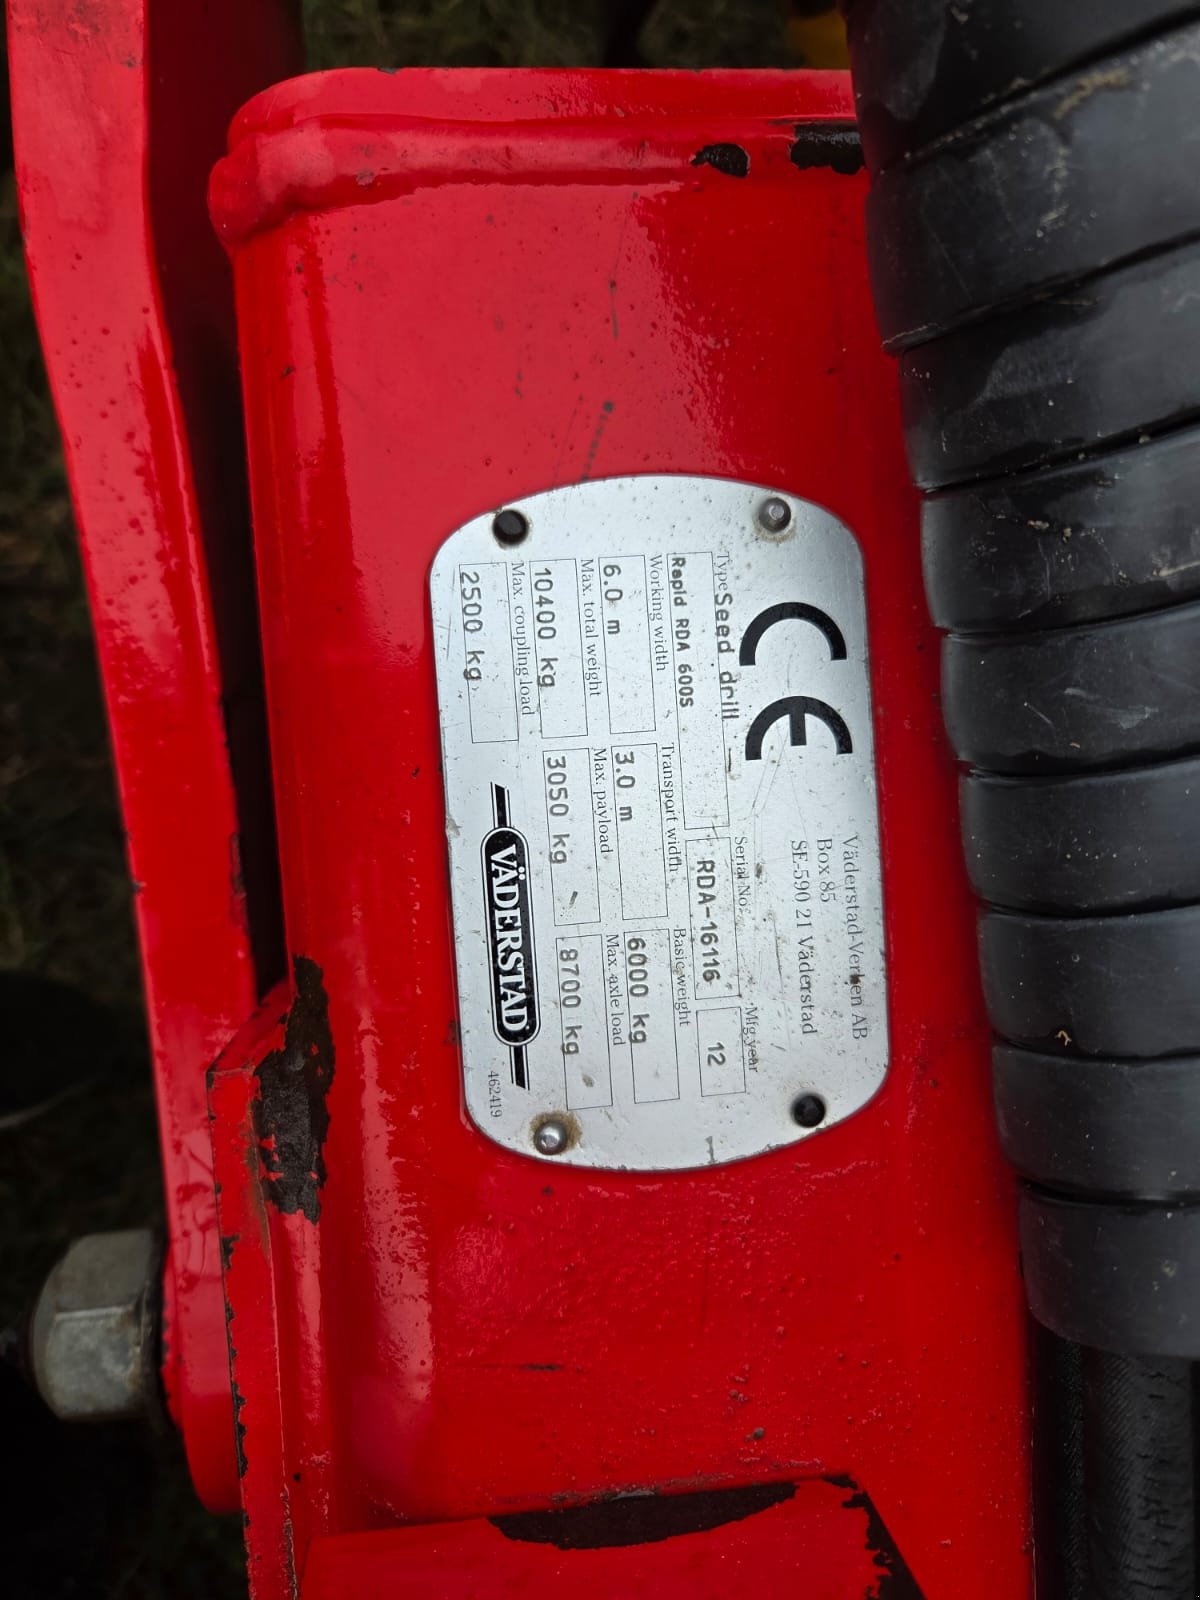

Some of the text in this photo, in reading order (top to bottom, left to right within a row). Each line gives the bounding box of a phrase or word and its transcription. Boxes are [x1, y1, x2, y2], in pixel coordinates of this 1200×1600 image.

[603, 564, 623, 635] 6.0 m
[650, 555, 669, 671] Working width
[714, 551, 730, 590] Type
[460, 571, 484, 680] 2500 kg
[512, 562, 535, 715] Max. coupling load
[534, 567, 558, 687] 10400 kg
[580, 559, 602, 697] Max. total weight
[669, 557, 694, 708] Rapid RDA 600S
[715, 592, 739, 720] Seed drill
[739, 602, 853, 761] CE
[547, 756, 570, 864] 3050 kg
[593, 748, 613, 854] Max. payload
[615, 751, 635, 821] 3.0 m
[661, 742, 682, 872] Transport width
[735, 836, 750, 880] Serial
[817, 838, 835, 903] Box 85
[490, 844, 529, 1031] VÄDERSTAD
[697, 860, 720, 982] RDA-16116
[792, 840, 817, 1035] SE-590 21 Väderstad
[560, 949, 583, 1055] 8700 kg
[606, 935, 626, 1046] Max. axle load
[627, 937, 650, 1044] 6000 kg
[673, 928, 691, 1027] Basic weight
[852, 1013, 868, 1040] AB
[488, 1071, 502, 1118] 462419
[707, 1042, 726, 1066] 12
[743, 1040, 758, 1072] year
